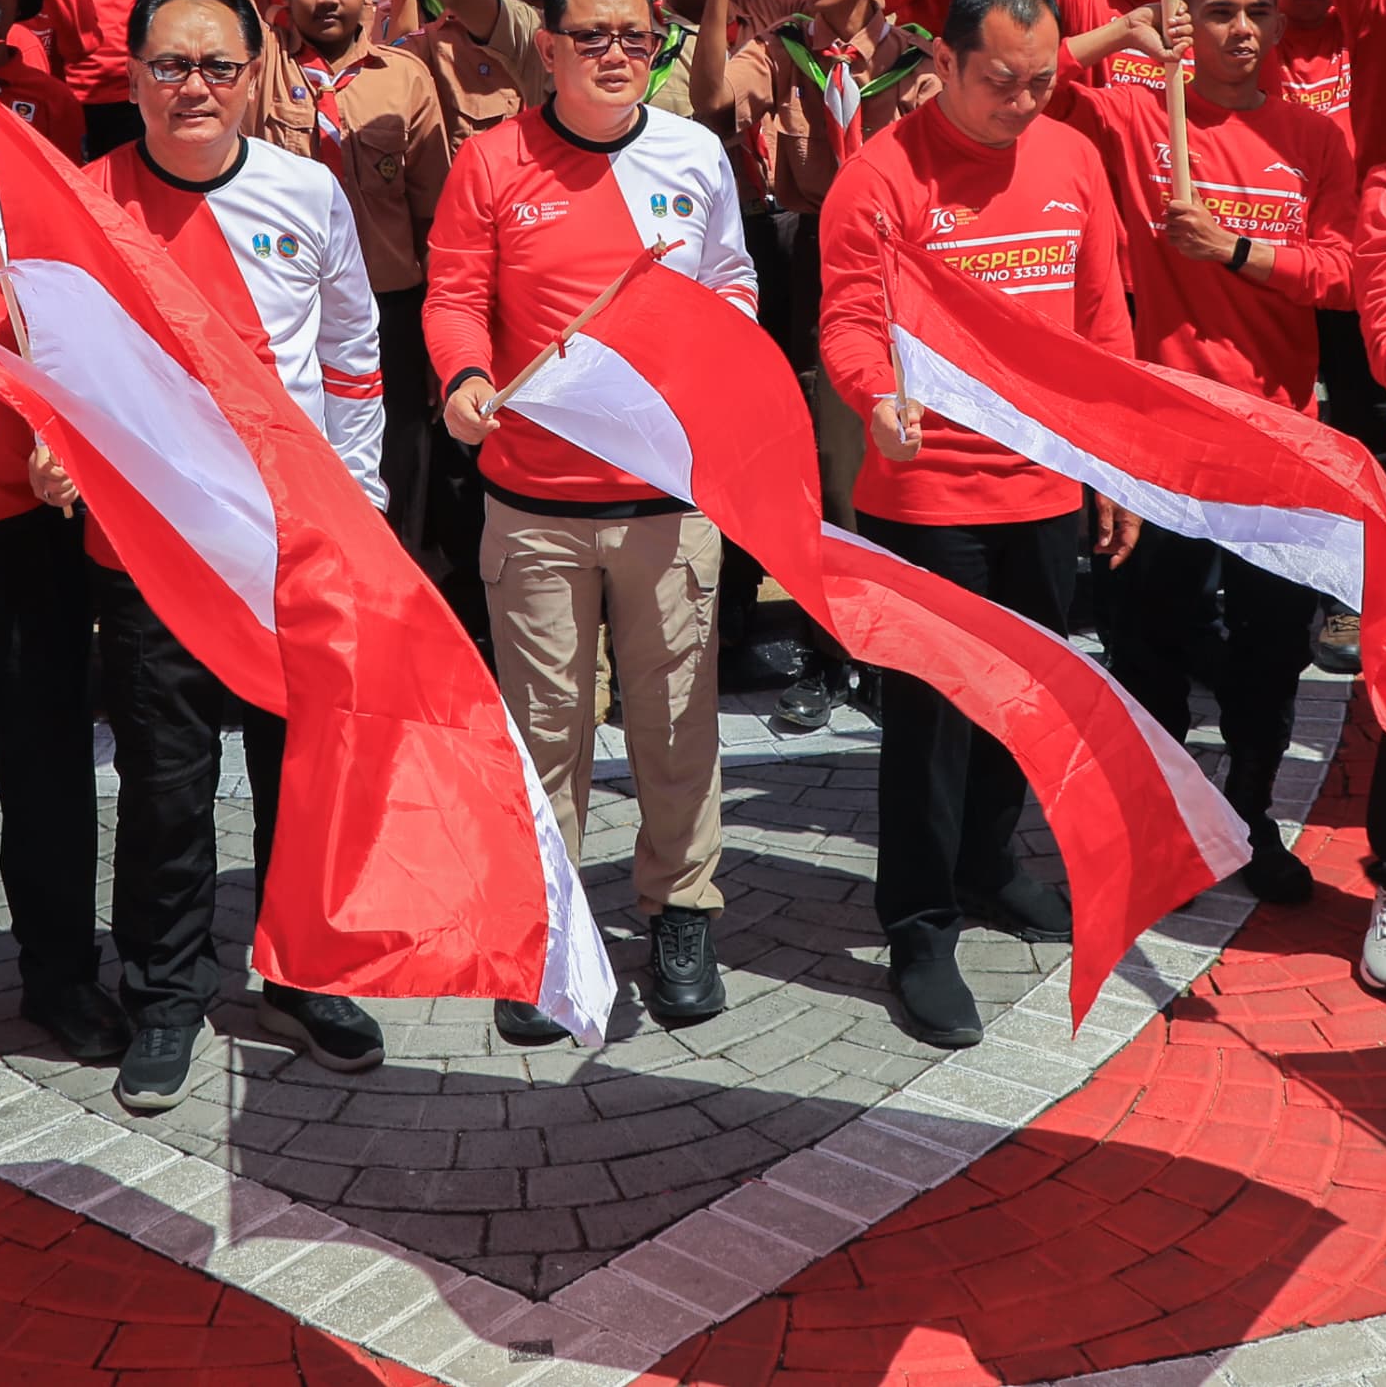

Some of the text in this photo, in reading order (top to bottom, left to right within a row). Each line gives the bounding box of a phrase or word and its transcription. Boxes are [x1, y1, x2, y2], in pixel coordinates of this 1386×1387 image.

[512, 201, 539, 226] 79
[1160, 191, 1283, 221] EPEDISI
[929, 207, 957, 235] 79
[1225, 215, 1258, 230] 3339
[1261, 223, 1302, 236] MDPL
[1012, 266, 1048, 280] 3339
